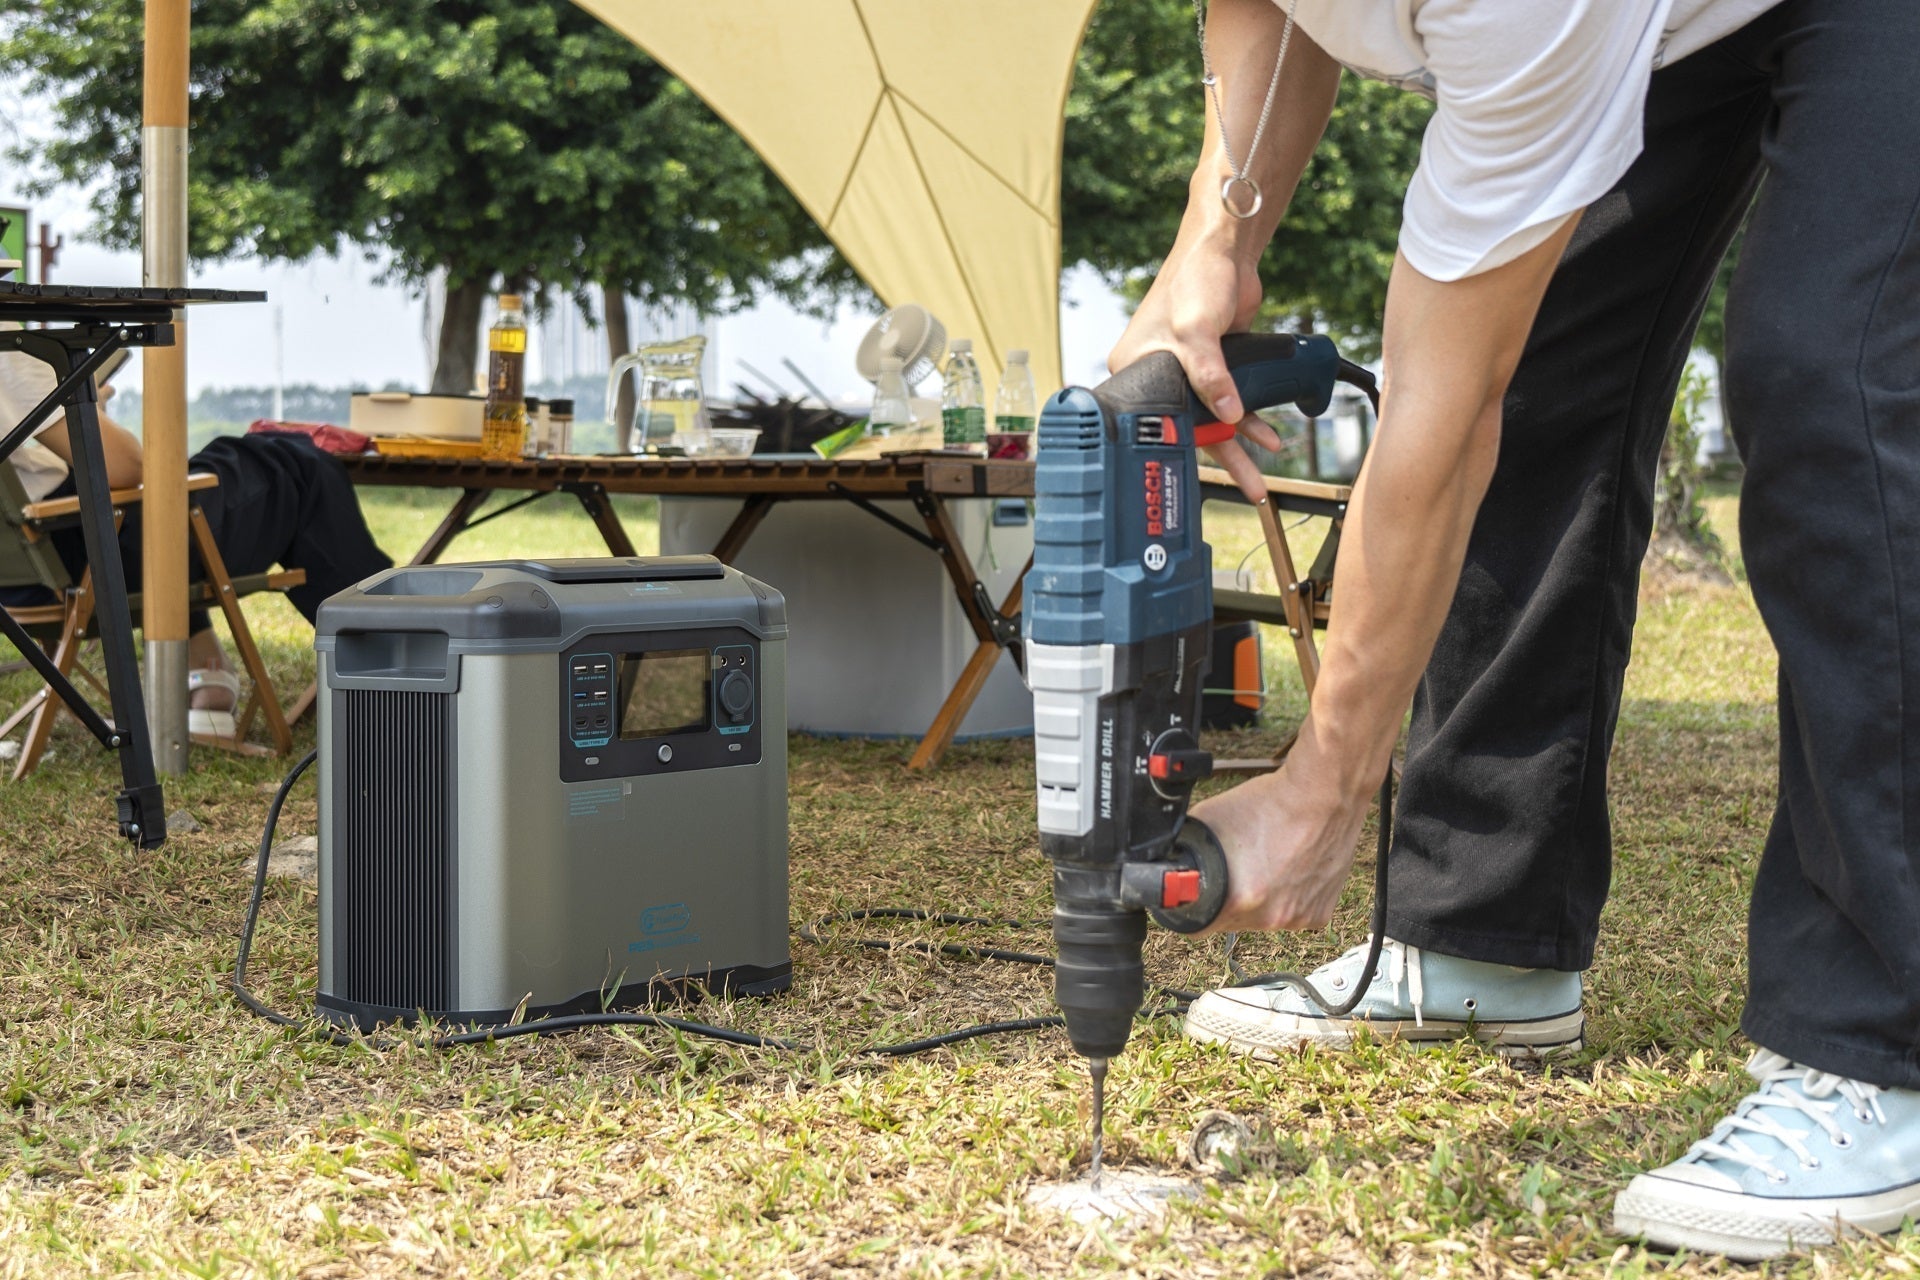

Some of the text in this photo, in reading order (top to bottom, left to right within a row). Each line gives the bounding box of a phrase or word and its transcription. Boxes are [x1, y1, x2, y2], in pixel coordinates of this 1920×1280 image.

[1145, 461, 1162, 535] BOSCH
[1101, 718, 1113, 819] HAMMER DRILL
